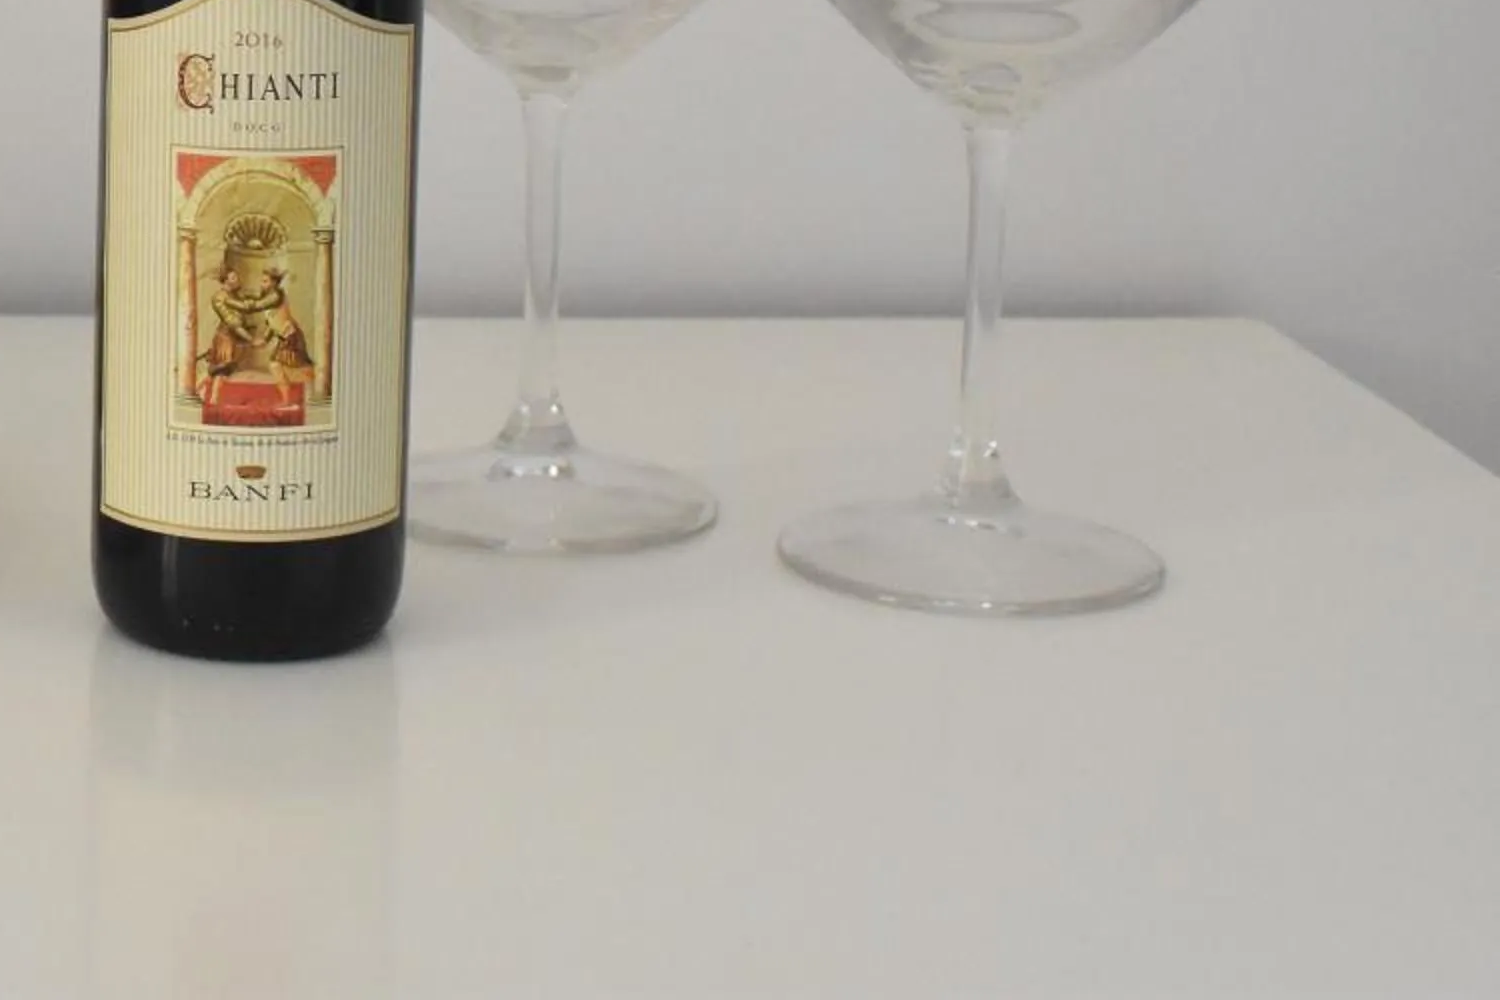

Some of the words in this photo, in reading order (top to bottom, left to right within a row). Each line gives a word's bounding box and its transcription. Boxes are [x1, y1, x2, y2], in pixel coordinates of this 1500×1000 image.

[234, 30, 283, 49] 2016
[177, 52, 340, 115] CHIANTI
[189, 481, 315, 502] BANFI
